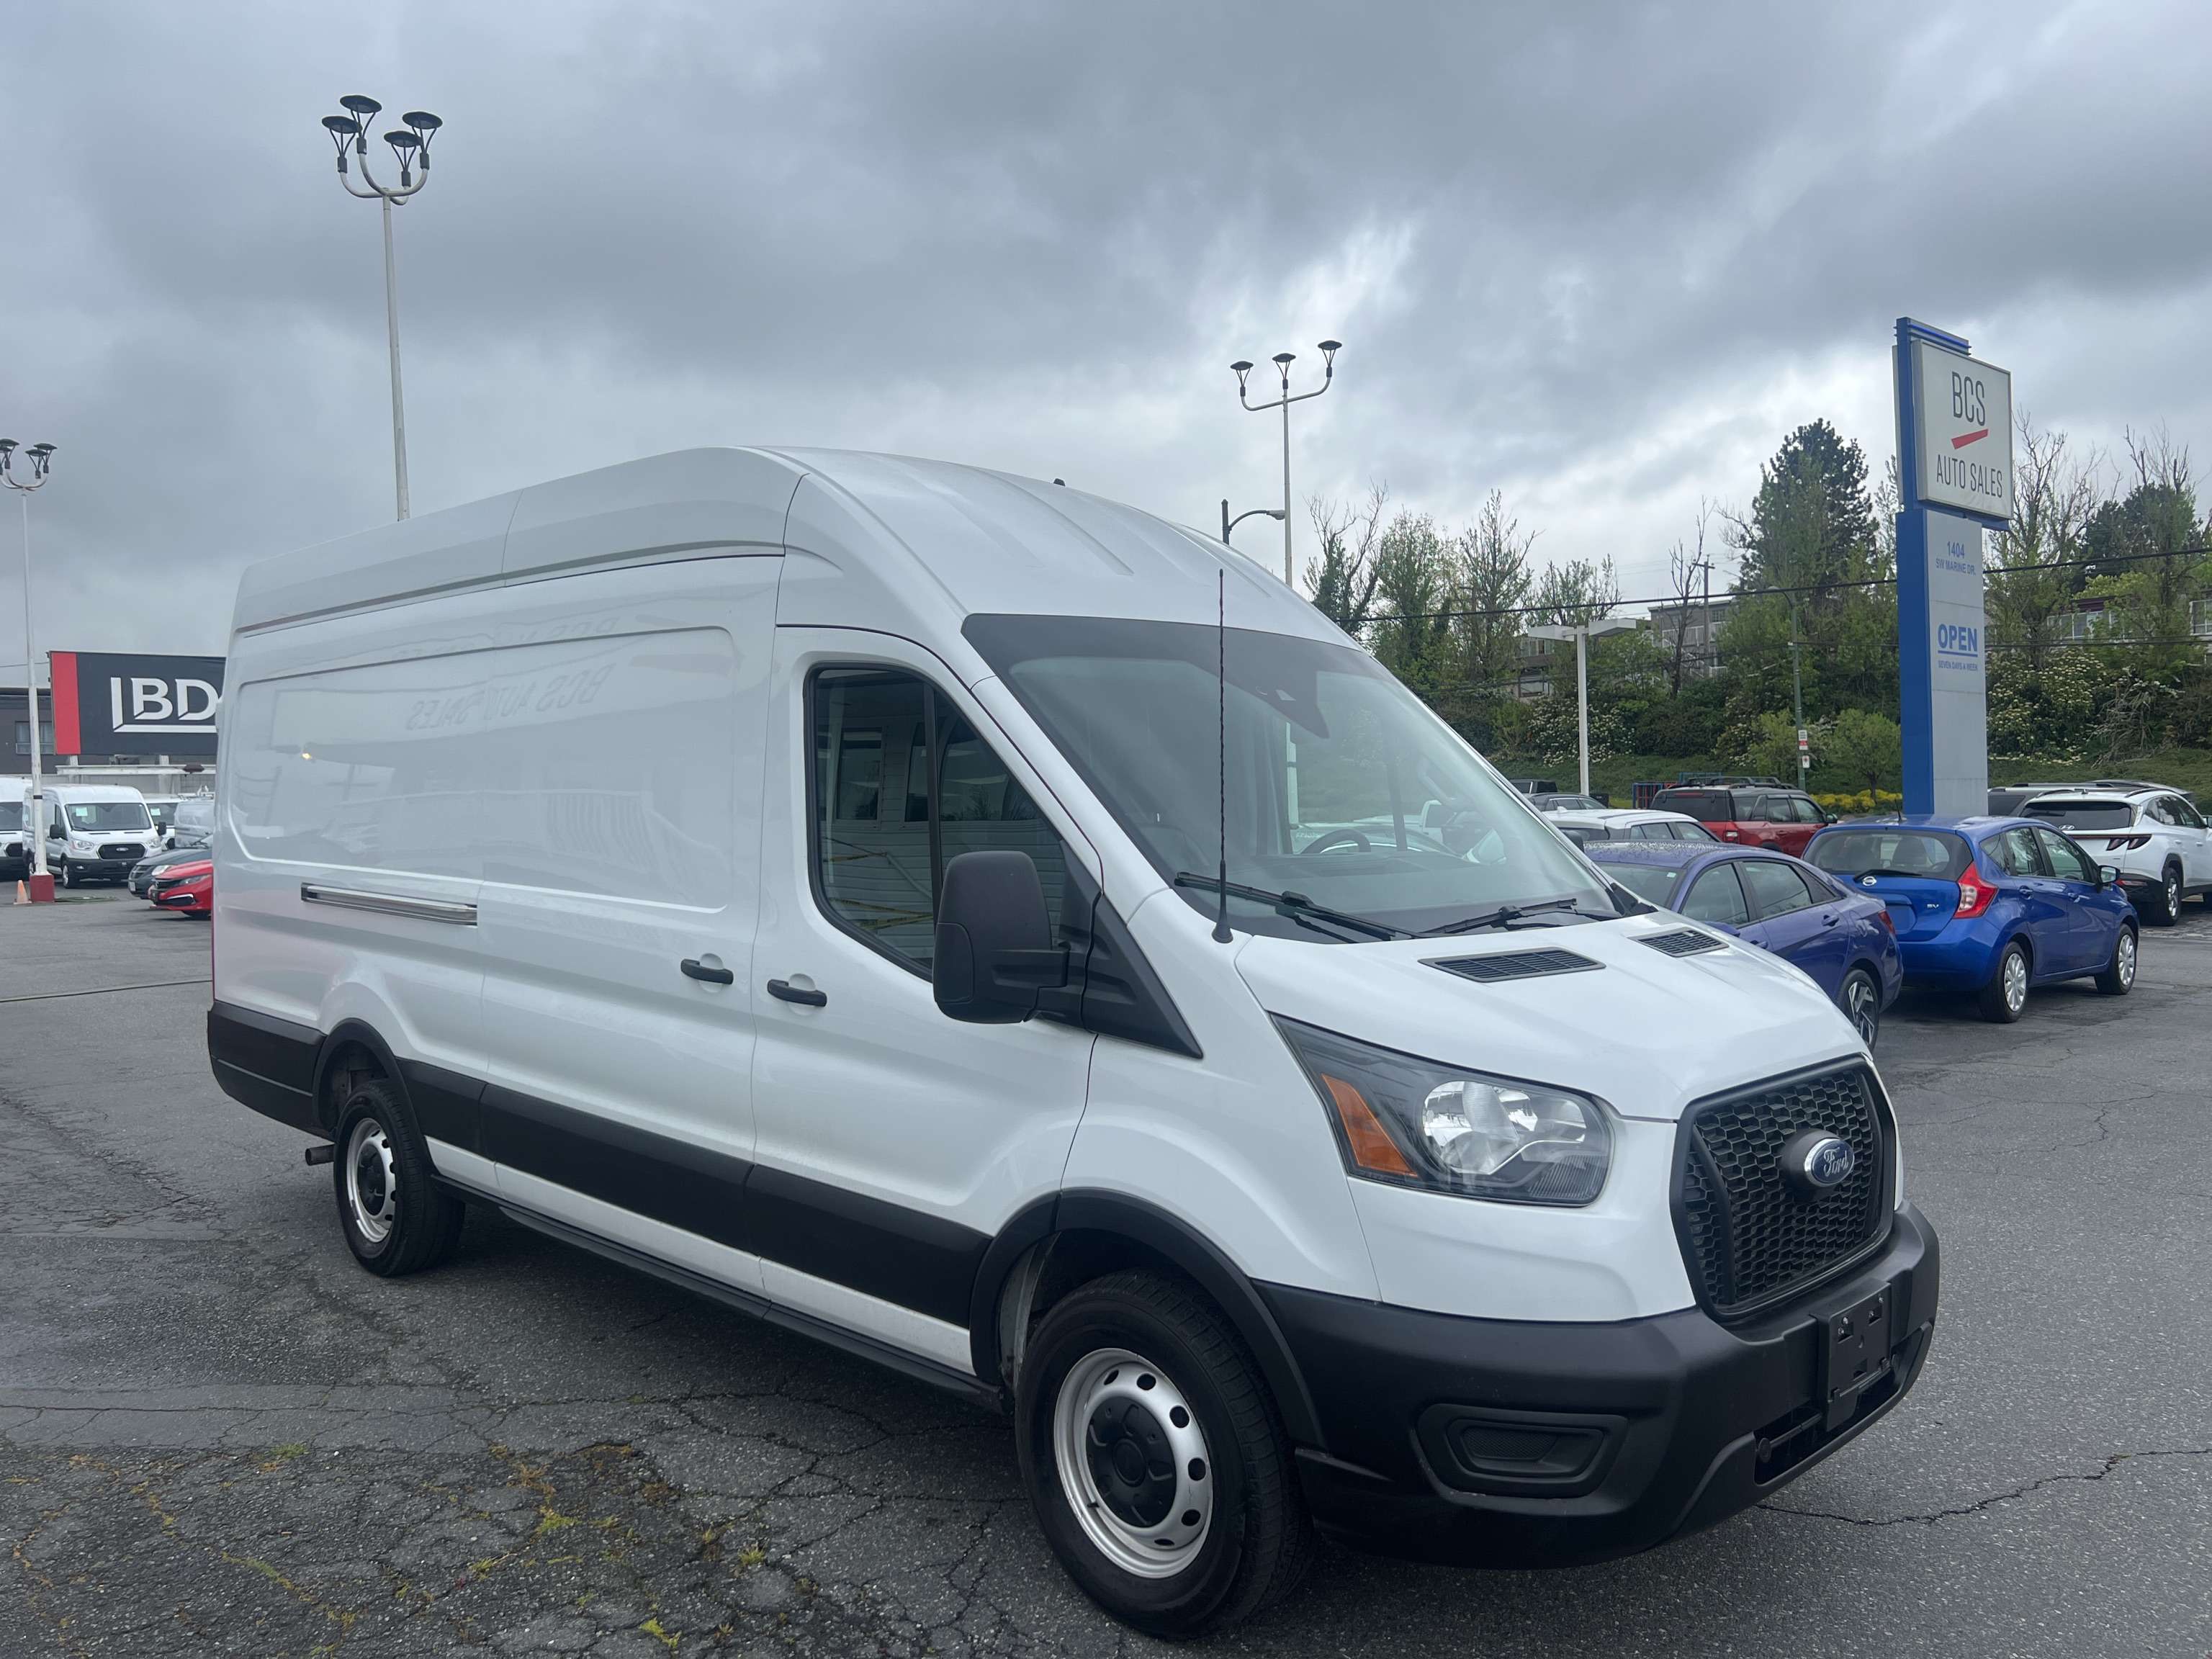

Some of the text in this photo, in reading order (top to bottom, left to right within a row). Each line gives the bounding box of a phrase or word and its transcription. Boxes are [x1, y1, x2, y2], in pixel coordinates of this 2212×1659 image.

[1951, 371, 1986, 426] BCS
[1936, 454, 2002, 498] AUTO SALES
[1947, 541, 1964, 559] 1404
[1936, 558, 1945, 569] SW
[1946, 559, 1966, 574] MARINE
[1938, 624, 1977, 652] OPEN
[130, 678, 223, 721] BD
[1823, 1146, 1849, 1177] Ford
